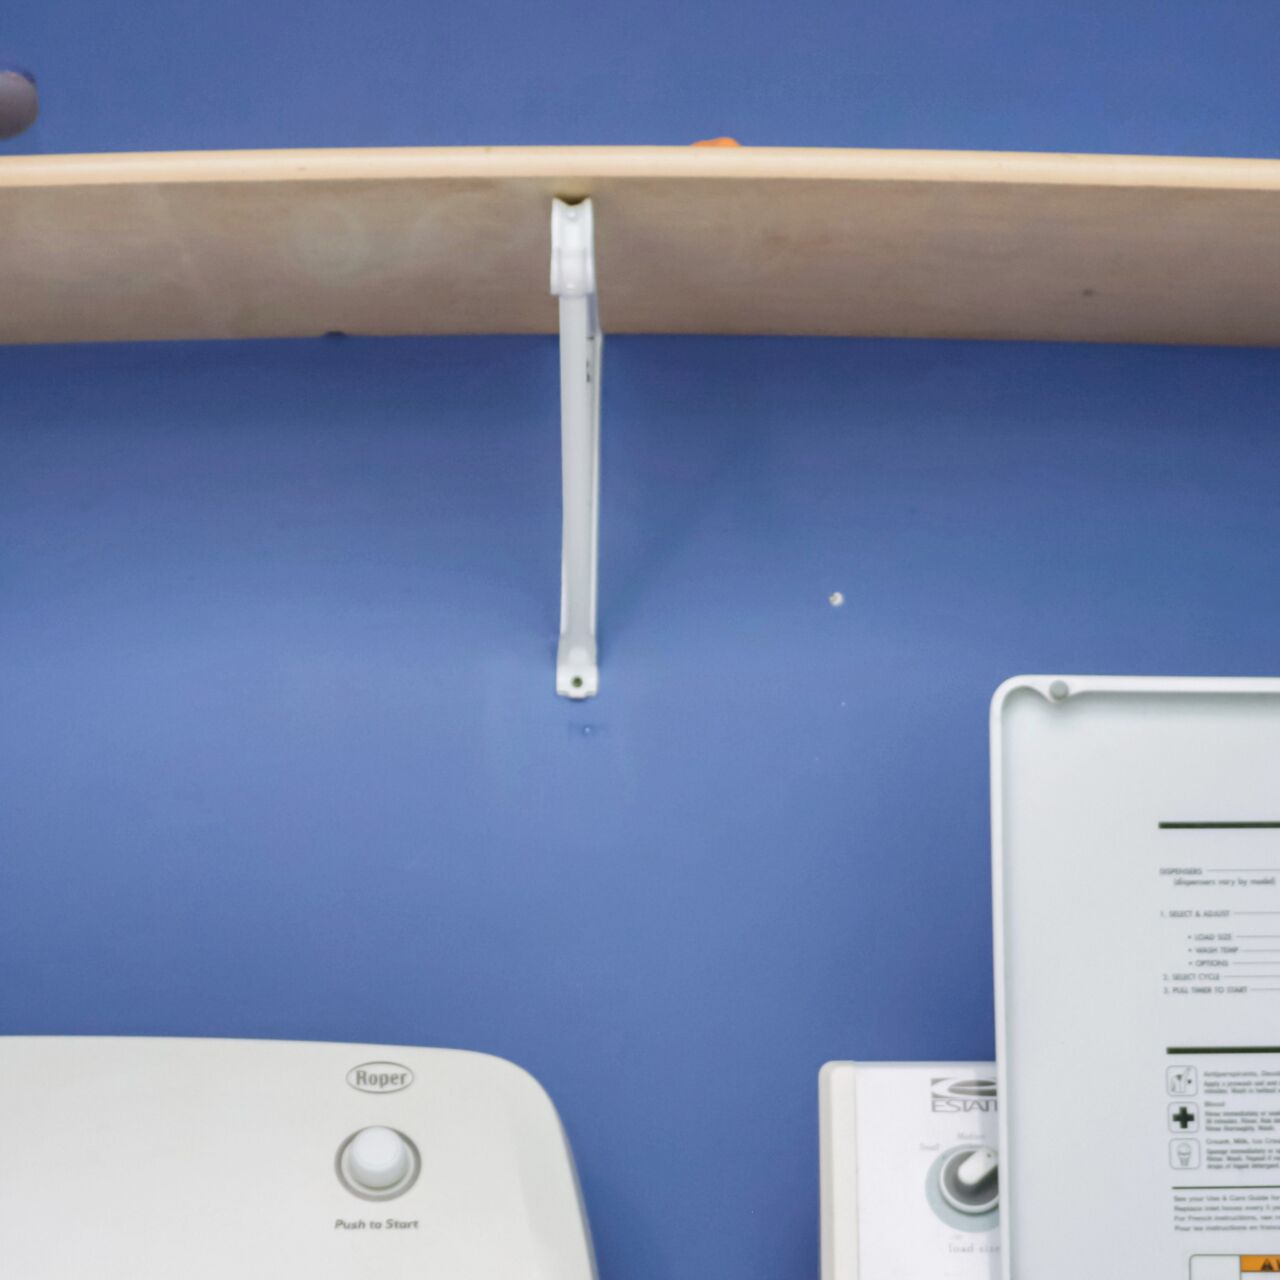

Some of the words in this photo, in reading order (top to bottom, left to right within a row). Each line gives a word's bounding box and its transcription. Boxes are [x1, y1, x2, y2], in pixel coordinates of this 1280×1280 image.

[355, 1070, 408, 1088] Roper
[334, 1219, 366, 1230] Push
[369, 1220, 382, 1229] to
[385, 1218, 419, 1230] Start
